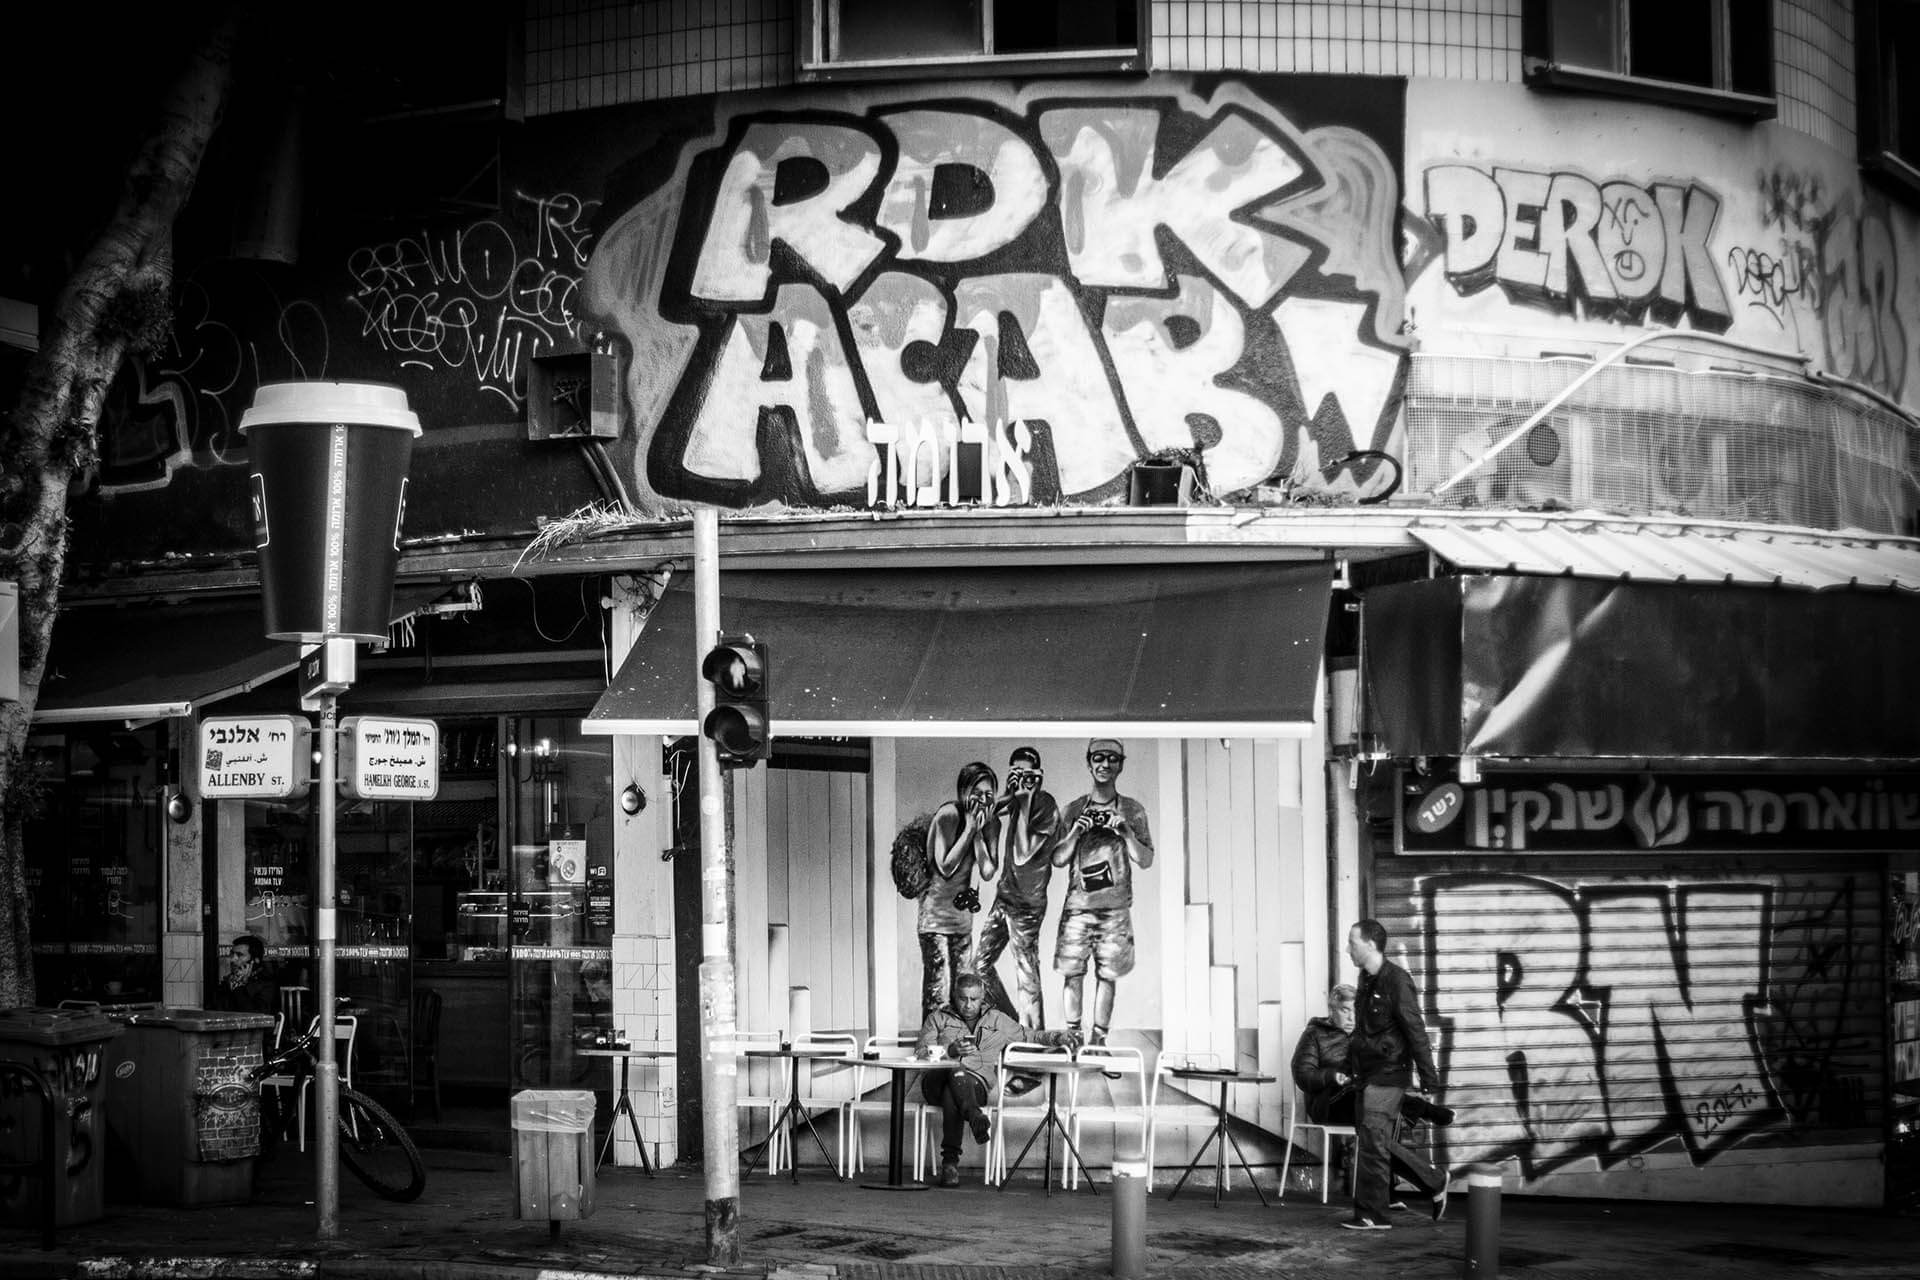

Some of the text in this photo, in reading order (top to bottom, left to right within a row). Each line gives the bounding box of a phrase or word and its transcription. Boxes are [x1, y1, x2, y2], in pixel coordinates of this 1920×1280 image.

[1424, 166, 1733, 333] DEROK
[866, 416, 1032, 508] ארומה
[209, 724, 260, 744] אלנבי
[207, 773, 285, 787] ALLENBY ST.
[393, 774, 417, 788] GEORGE
[1422, 791, 1456, 823] כשר
